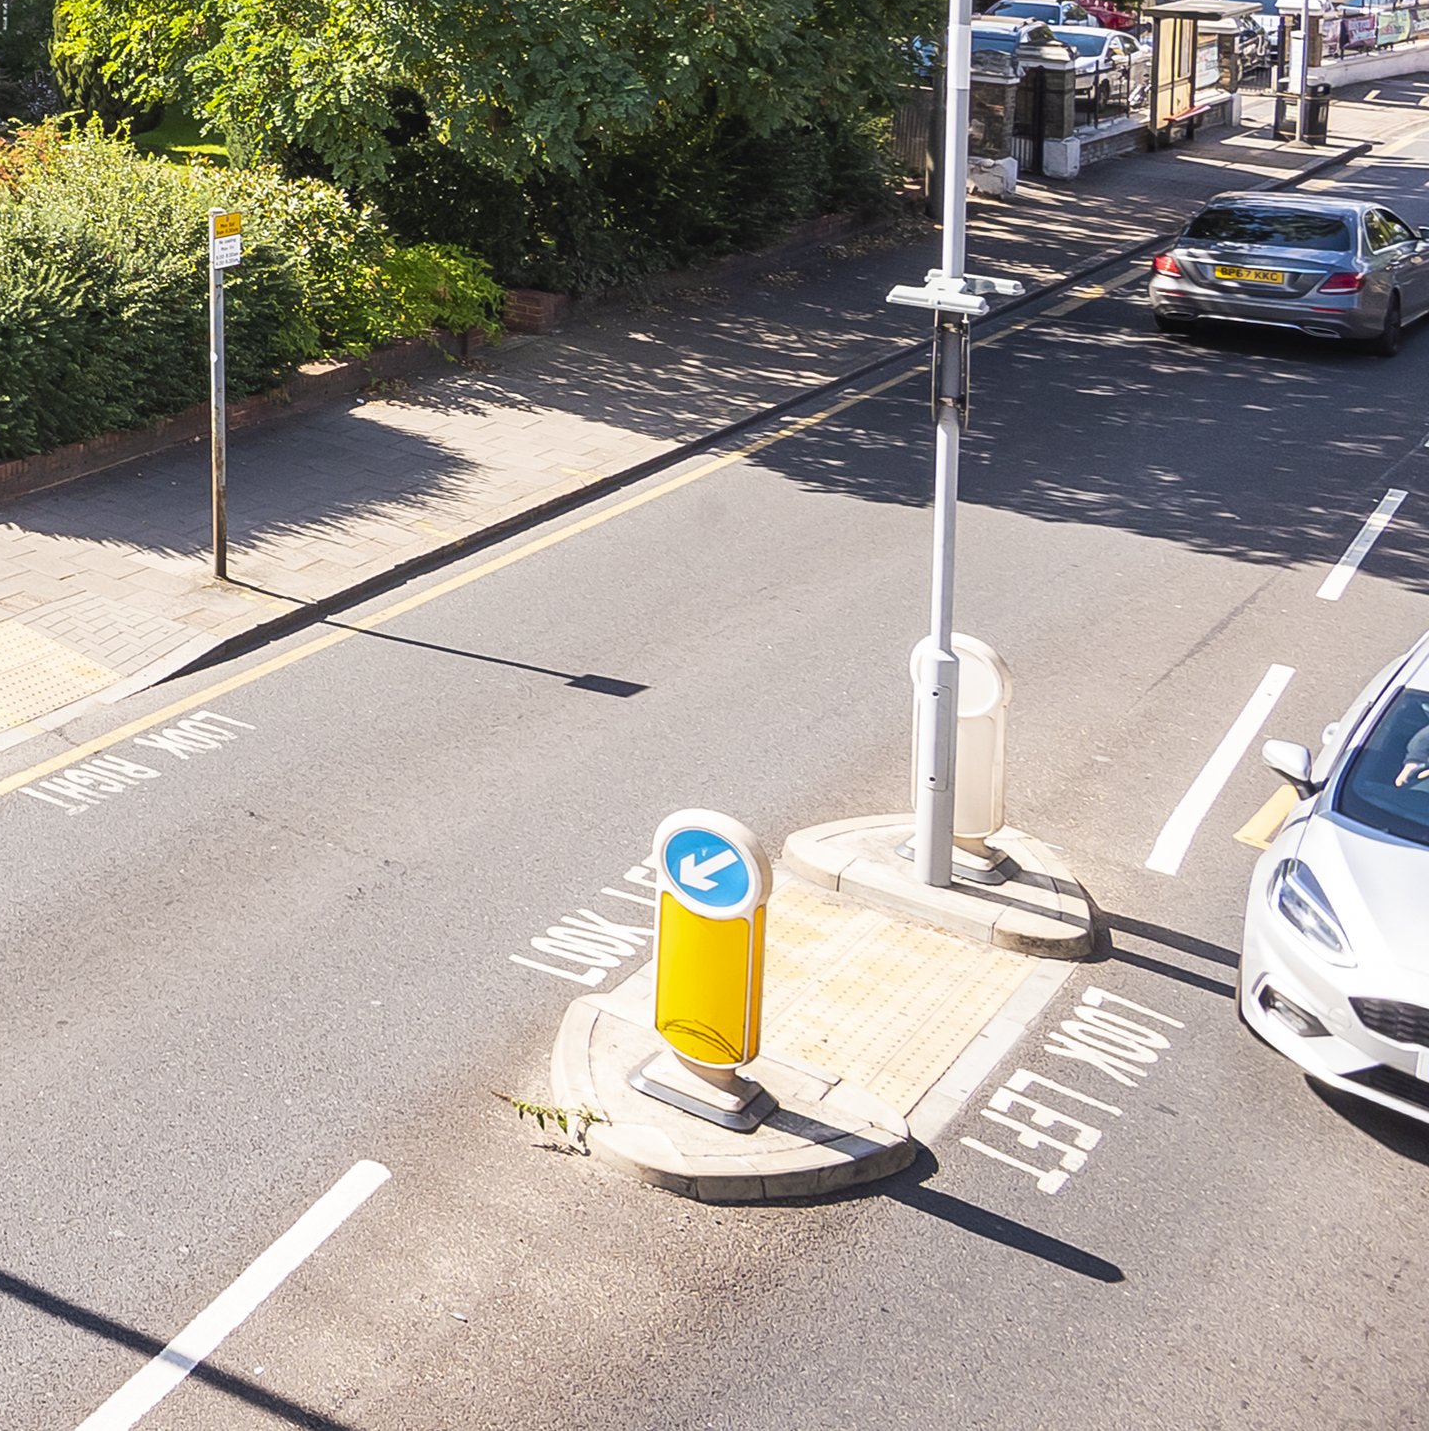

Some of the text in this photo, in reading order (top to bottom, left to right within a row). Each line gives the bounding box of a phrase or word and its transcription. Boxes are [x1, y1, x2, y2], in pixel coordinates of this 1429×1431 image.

[1254, 272, 1278, 281] KKC
[18, 710, 257, 817] LOOK RIGHT
[508, 907, 656, 987] LOOK
[959, 985, 1185, 1195] LOOK LEFT
